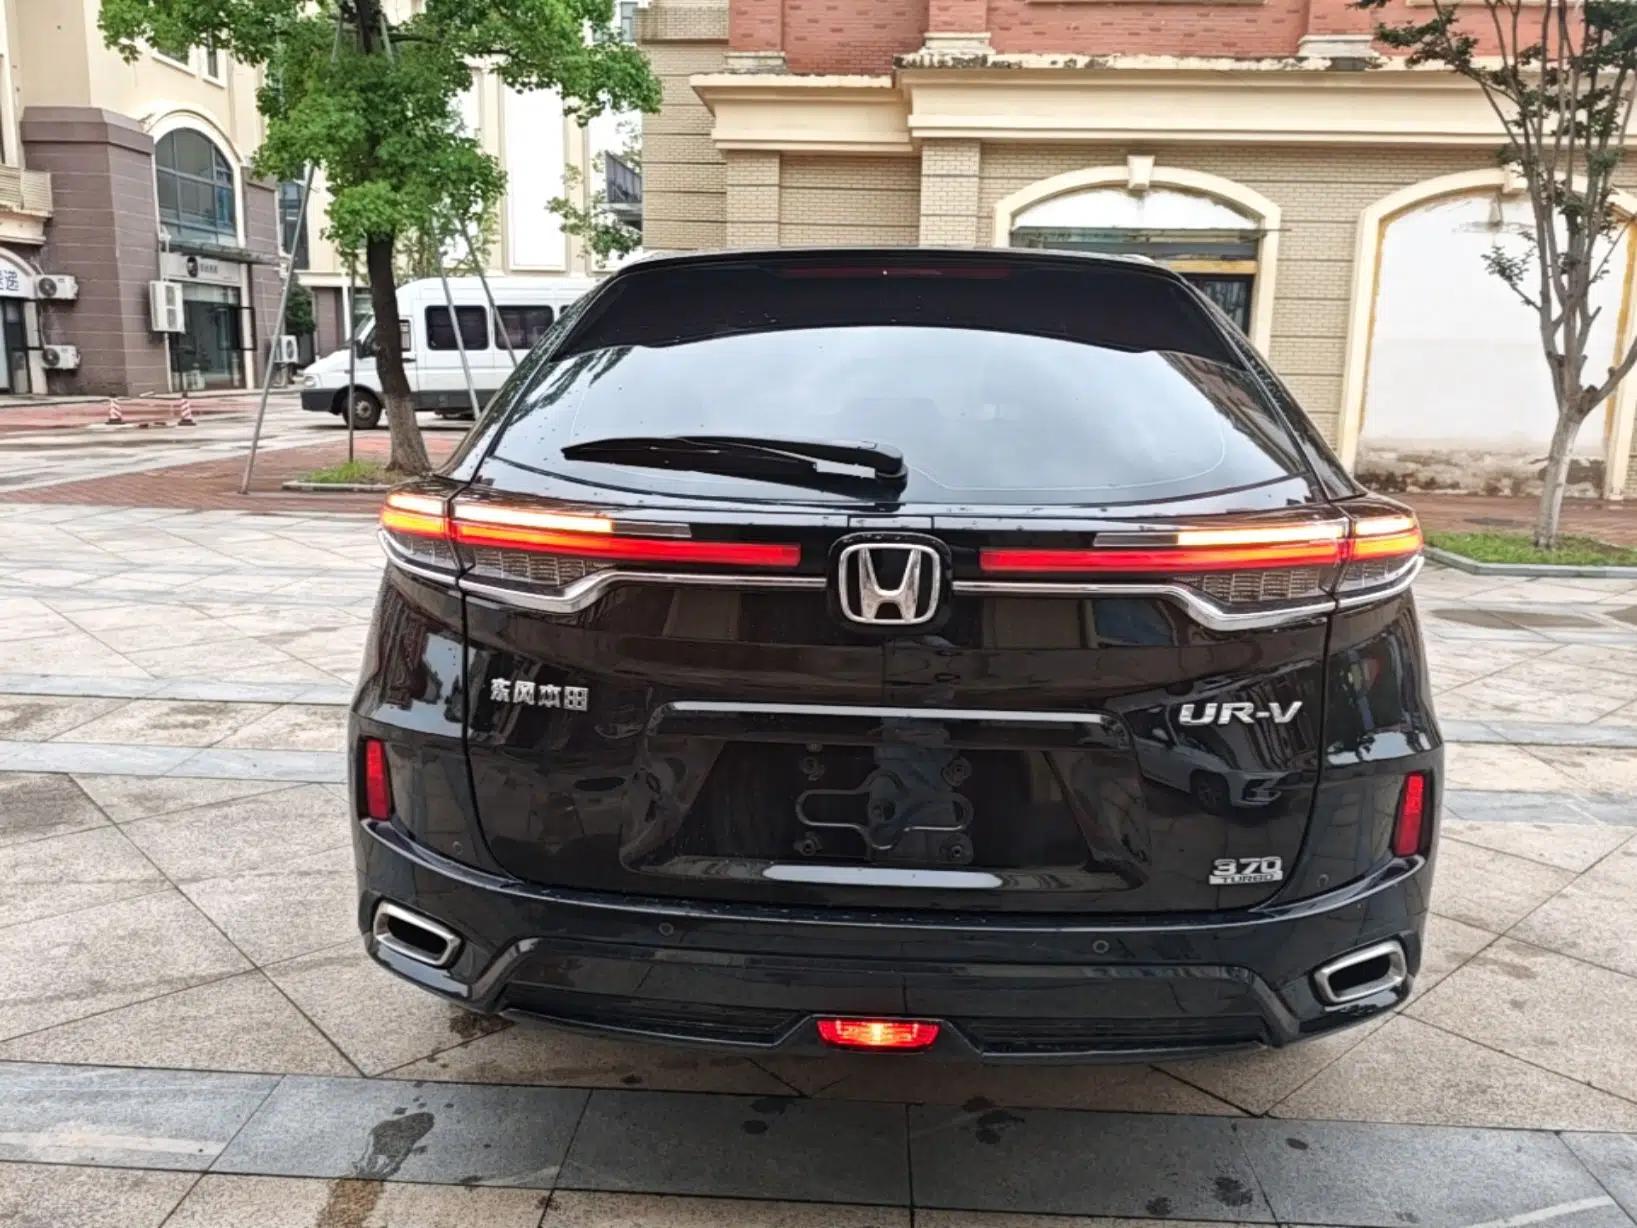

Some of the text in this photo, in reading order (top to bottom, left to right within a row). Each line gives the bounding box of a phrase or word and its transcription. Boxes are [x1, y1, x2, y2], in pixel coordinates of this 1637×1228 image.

[0, 269, 19, 291] 递
[490, 678, 589, 711] 东风本田
[1179, 701, 1303, 725] UR-V
[1213, 856, 1281, 875] 370
